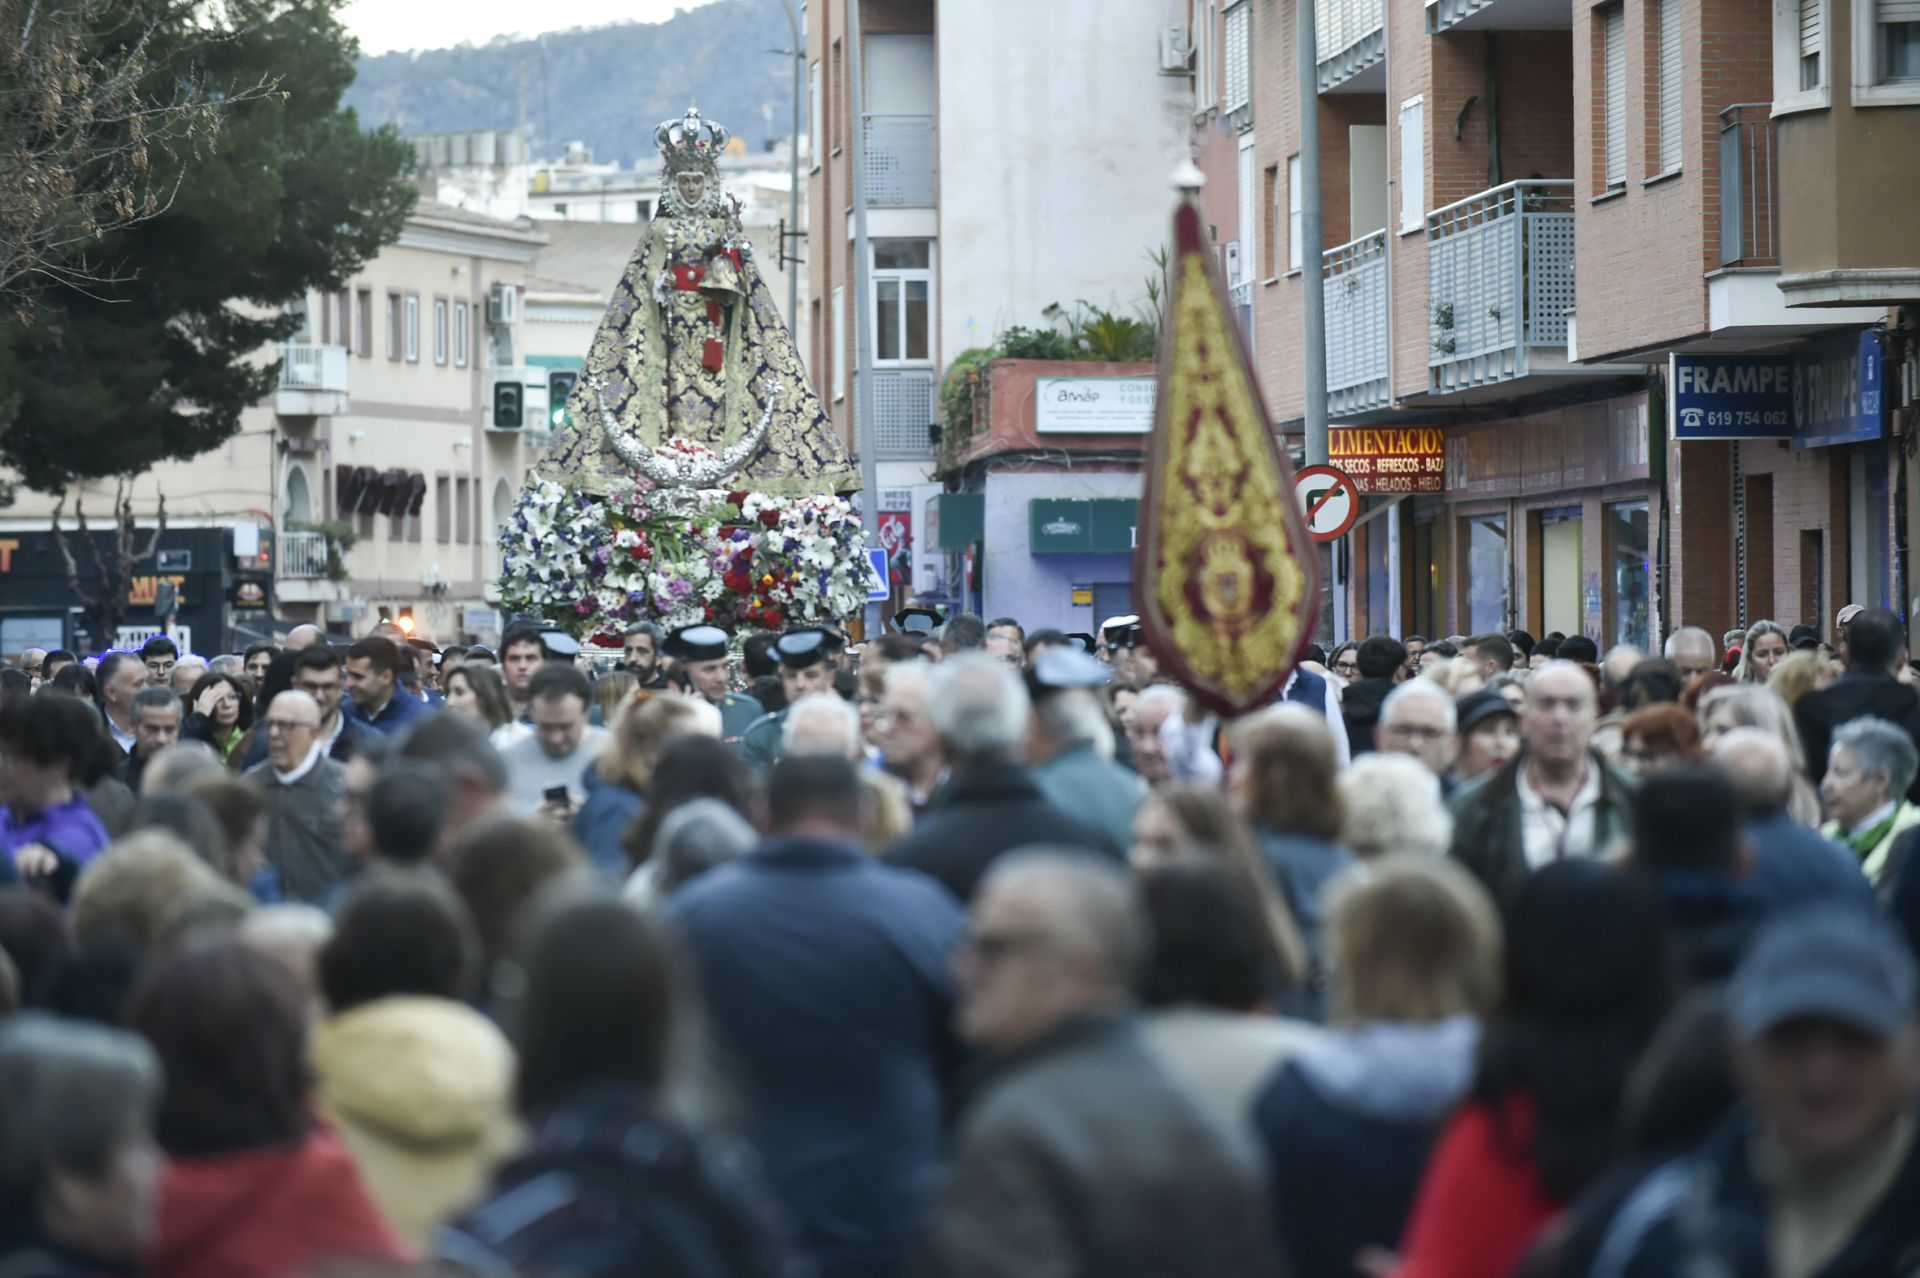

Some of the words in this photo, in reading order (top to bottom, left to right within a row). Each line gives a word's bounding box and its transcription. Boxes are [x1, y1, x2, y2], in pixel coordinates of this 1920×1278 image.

[1679, 366, 1788, 394] FRAMPE
[1708, 411, 1732, 425] 619
[1736, 411, 1760, 425] 754
[1764, 411, 1788, 425] 062
[1344, 459, 1370, 473] SECOS
[1377, 458, 1419, 472] REFRESCOS
[1376, 477, 1412, 491] HELADOS
[1419, 476, 1441, 490] HIELO
